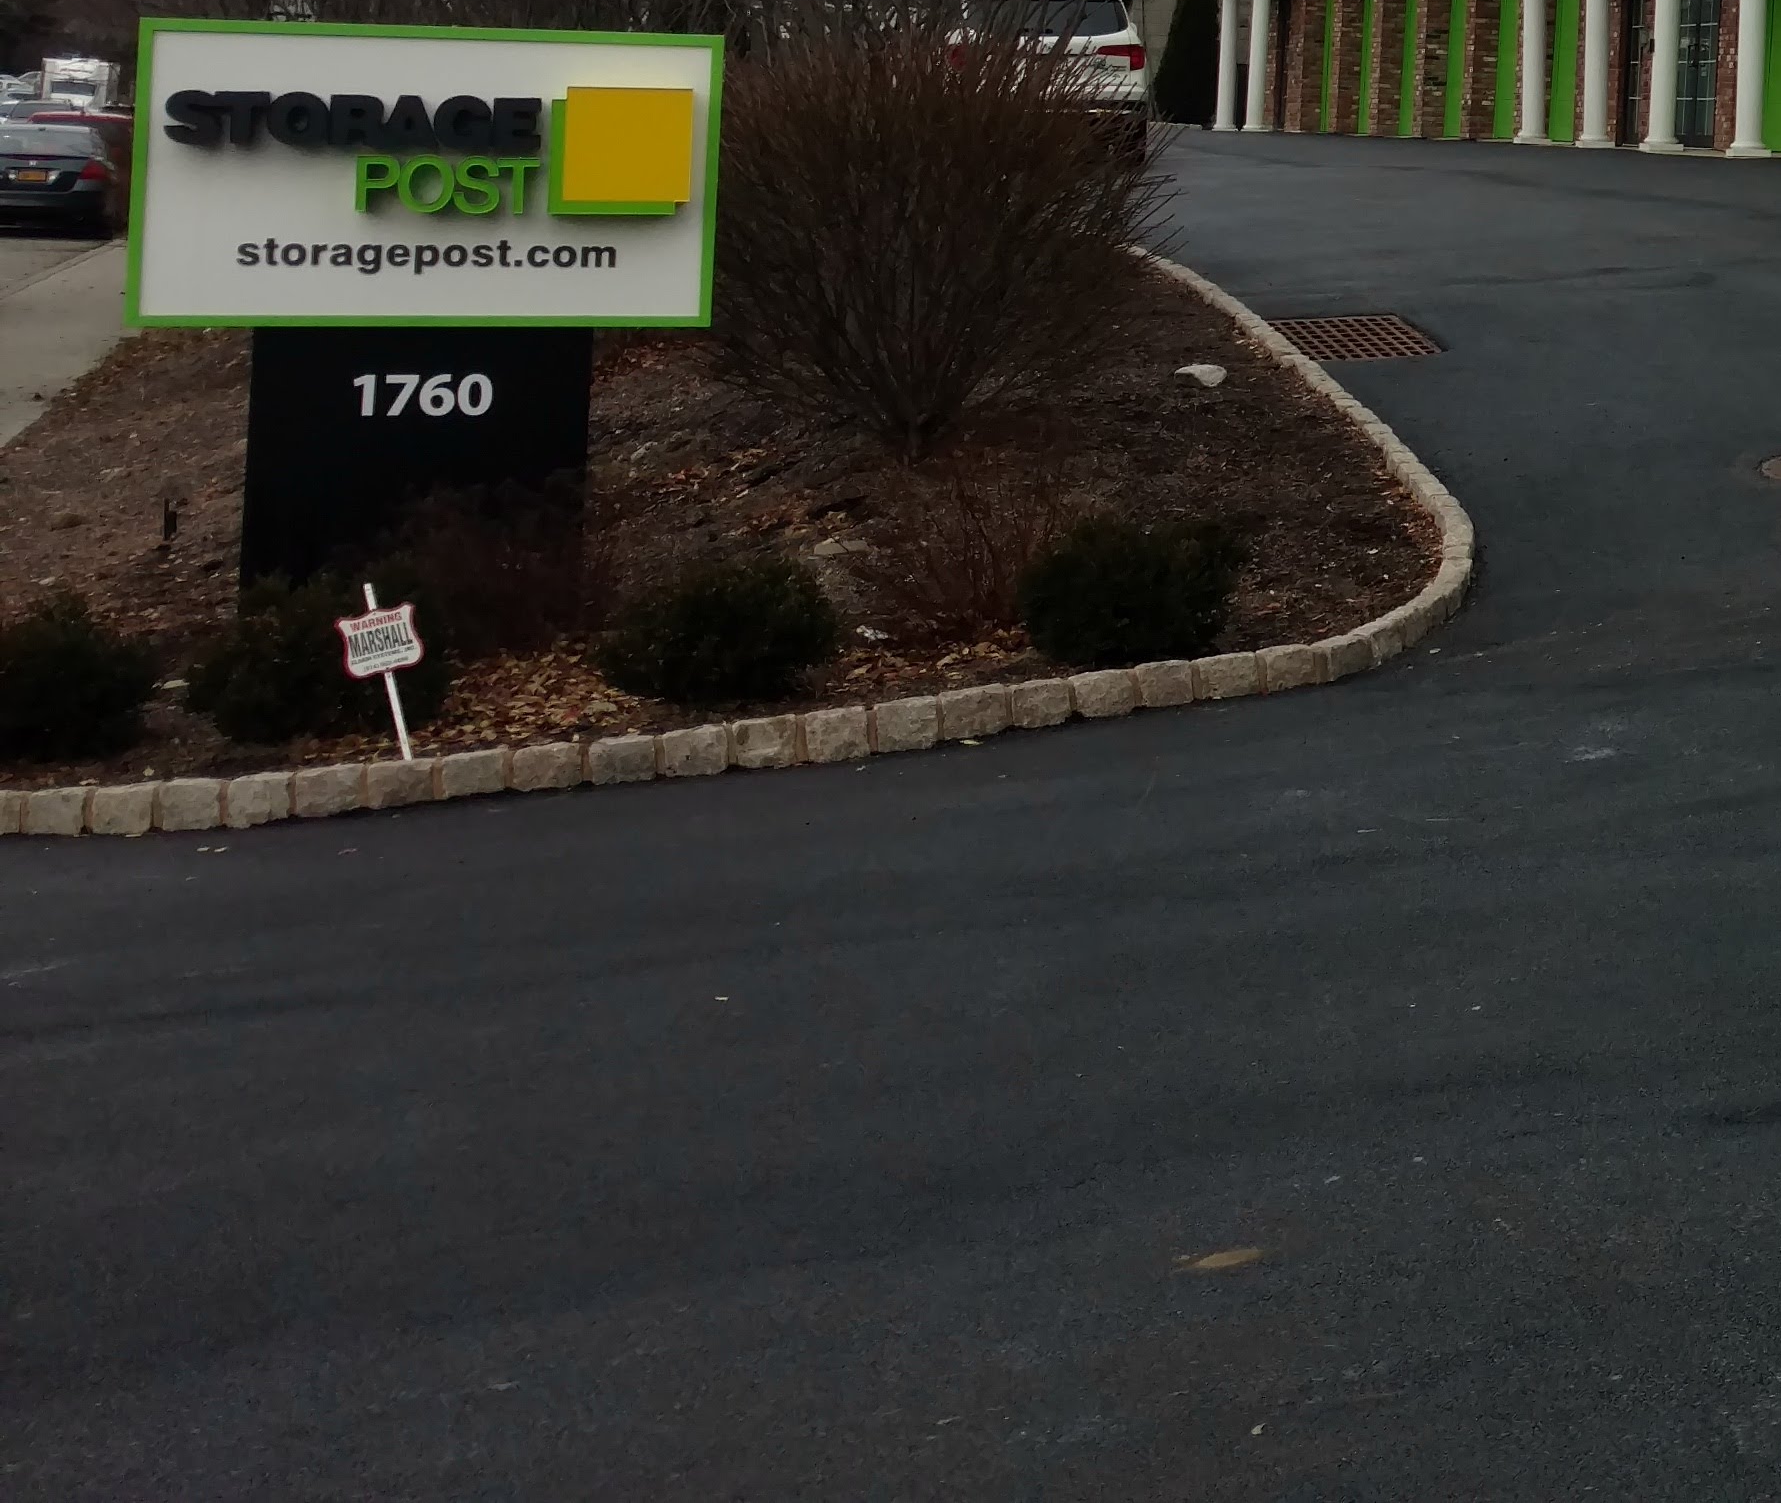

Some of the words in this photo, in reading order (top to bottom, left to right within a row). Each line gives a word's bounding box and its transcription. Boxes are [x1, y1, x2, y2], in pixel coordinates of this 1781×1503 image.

[163, 89, 543, 152] STORAGE
[354, 154, 541, 216] POST
[236, 236, 618, 275] storagepost.com
[352, 372, 494, 417] 1760
[348, 622, 413, 658] MARSHALL
[350, 612, 402, 632] WARNING
